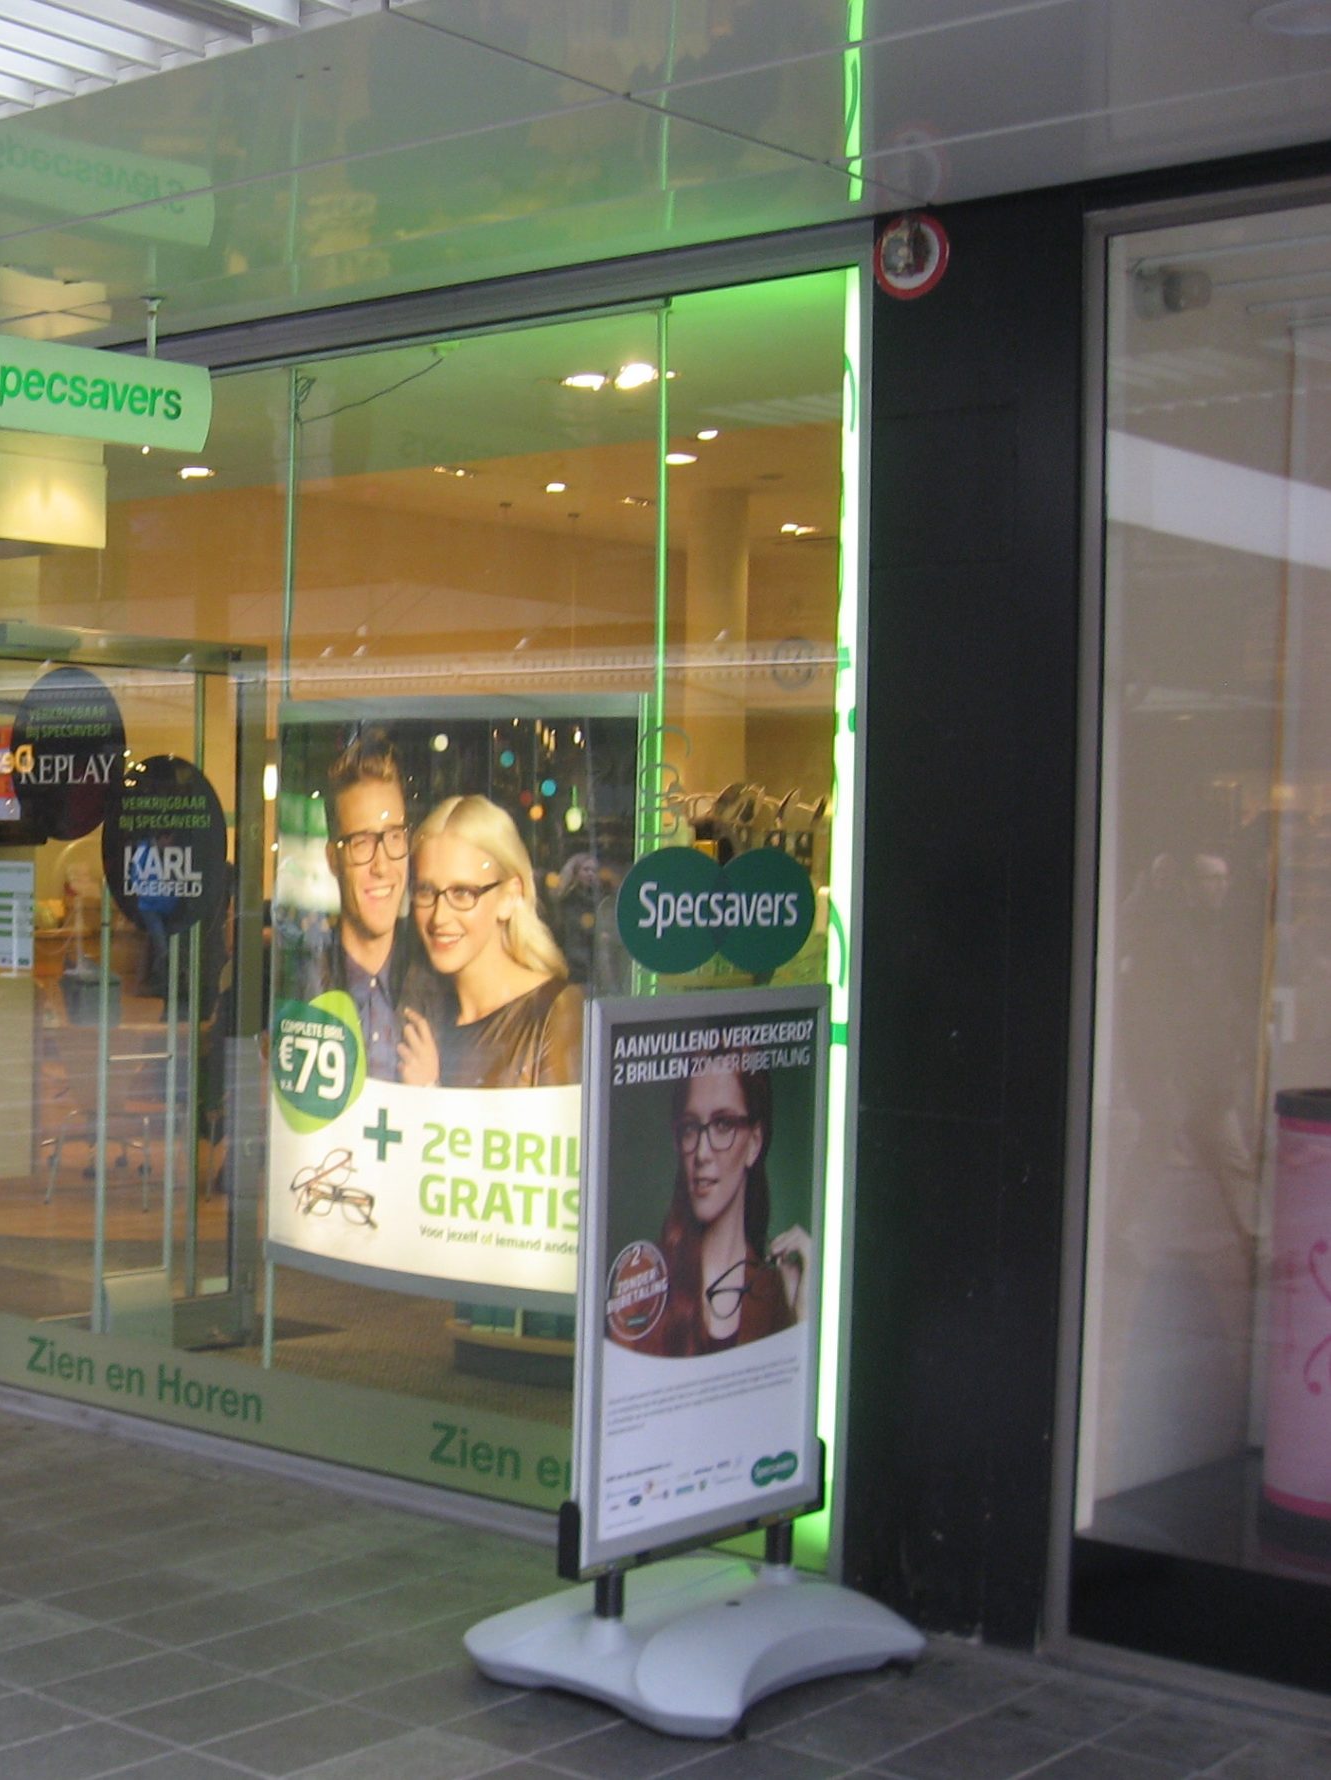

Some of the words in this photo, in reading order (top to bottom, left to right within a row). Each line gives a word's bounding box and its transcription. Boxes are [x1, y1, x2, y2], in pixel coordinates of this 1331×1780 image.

[123, 844, 202, 880] KARL
[123, 880, 202, 897] LAGERFELD
[638, 881, 799, 939] Specsavers
[278, 1035, 346, 1100] €79
[613, 1028, 720, 1060] AANVULLEND
[722, 1018, 814, 1048] VERZEKERD?
[614, 1064, 624, 1086] 2
[626, 1056, 690, 1085] BRILLEN
[422, 1121, 472, 1164] 2e
[482, 1128, 581, 1179] BRIL
[419, 1173, 580, 1233] GRATIS
[419, 1225, 443, 1239] Voor
[446, 1228, 477, 1243] jezelf
[495, 1235, 541, 1251] iemand
[26, 1335, 95, 1385] Zien
[105, 1361, 145, 1397] en
[157, 1362, 263, 1424] Horen
[429, 1421, 521, 1481] Zien
